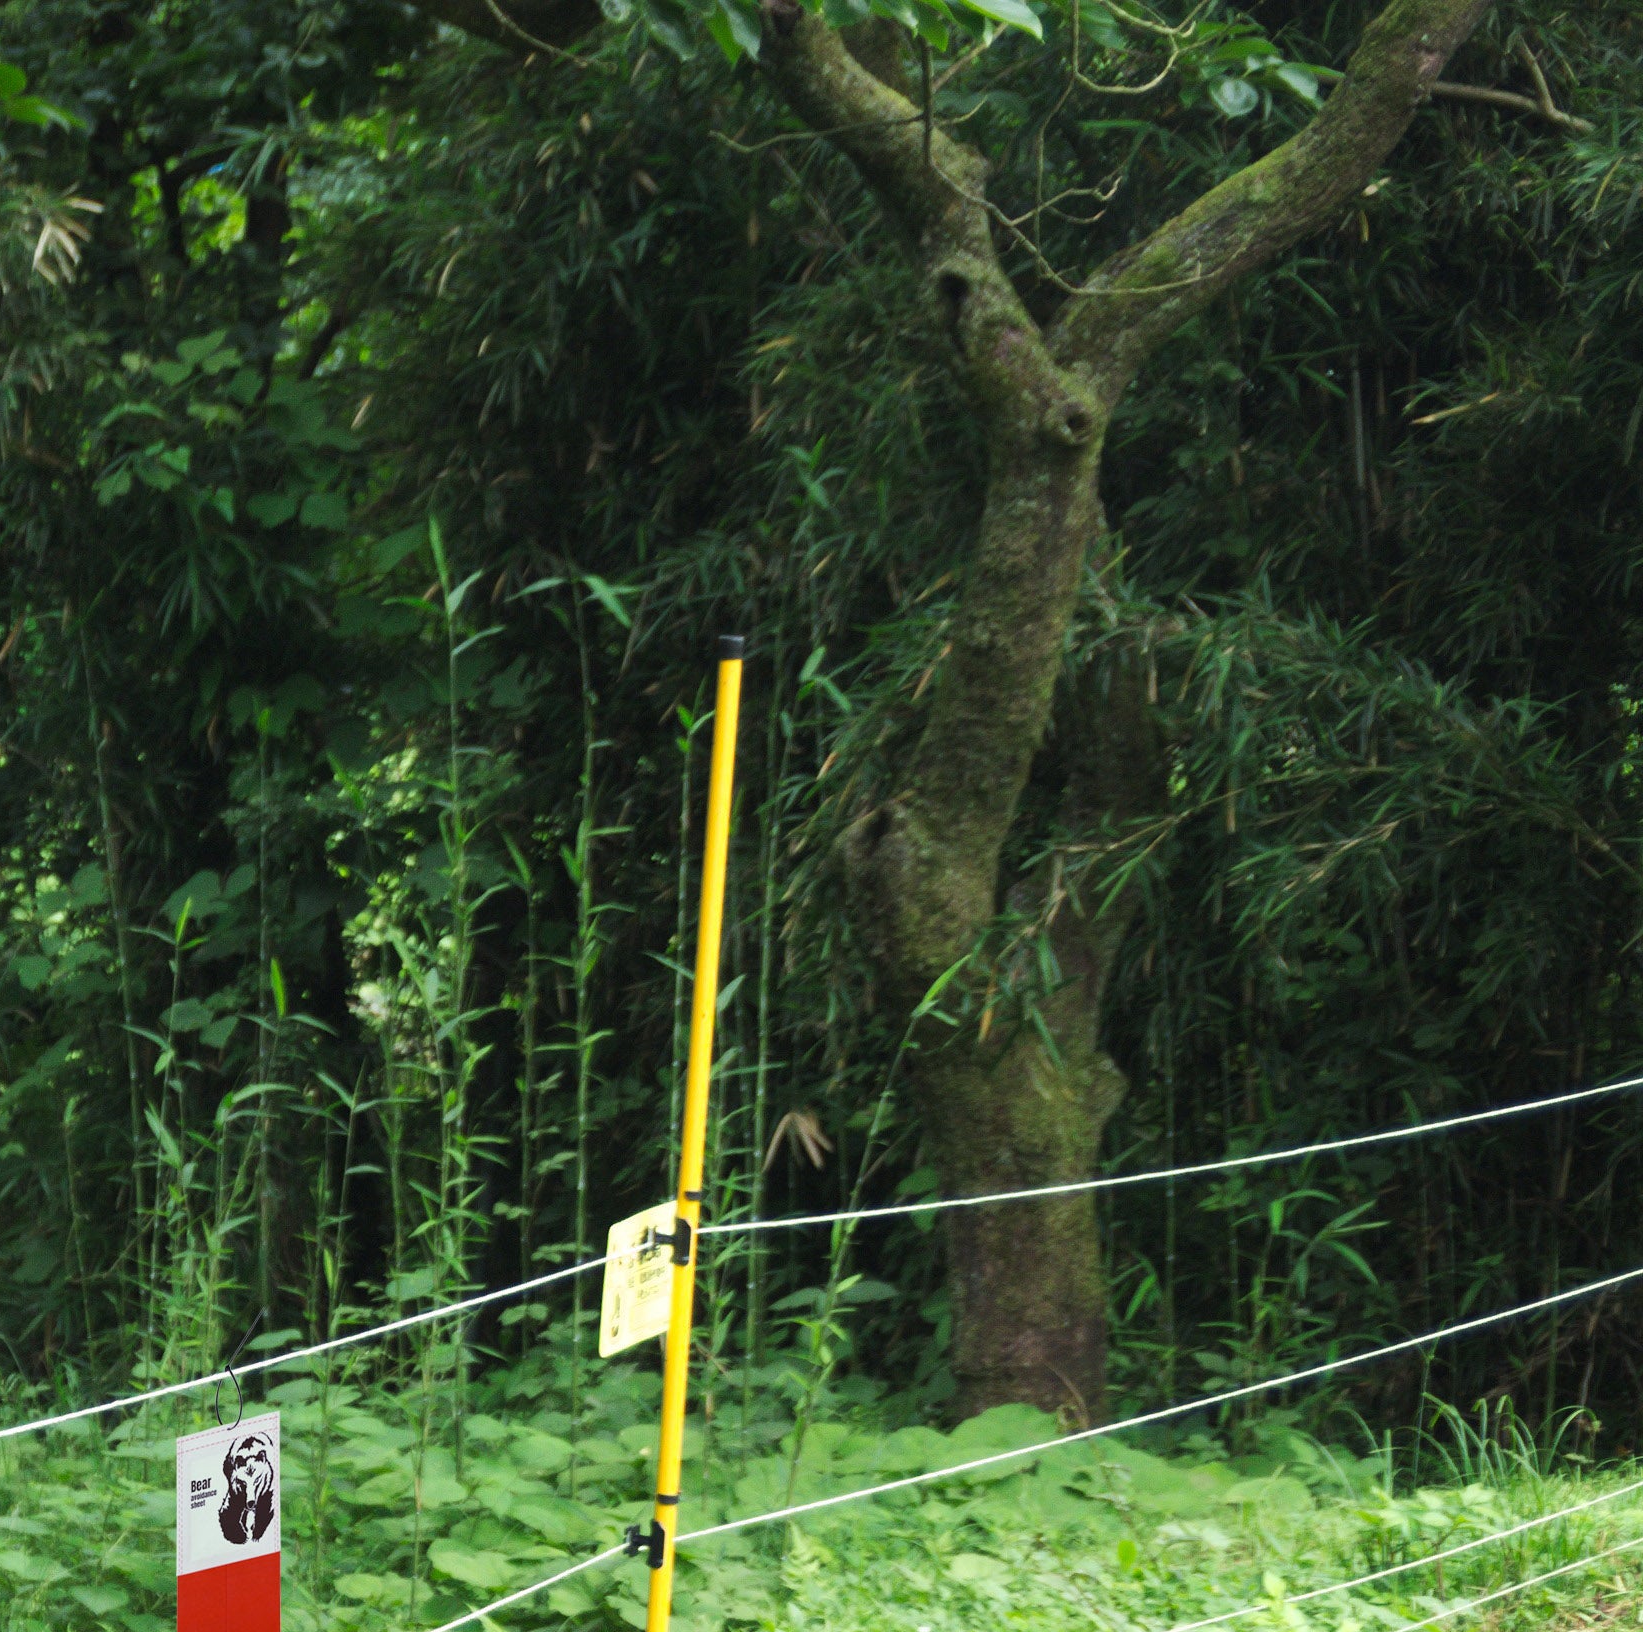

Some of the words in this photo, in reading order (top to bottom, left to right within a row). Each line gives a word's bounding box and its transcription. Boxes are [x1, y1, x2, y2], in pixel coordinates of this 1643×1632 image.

[190, 1477, 212, 1493] Bear
[190, 1489, 217, 1502] avoidance
[190, 1500, 206, 1510] sheet
